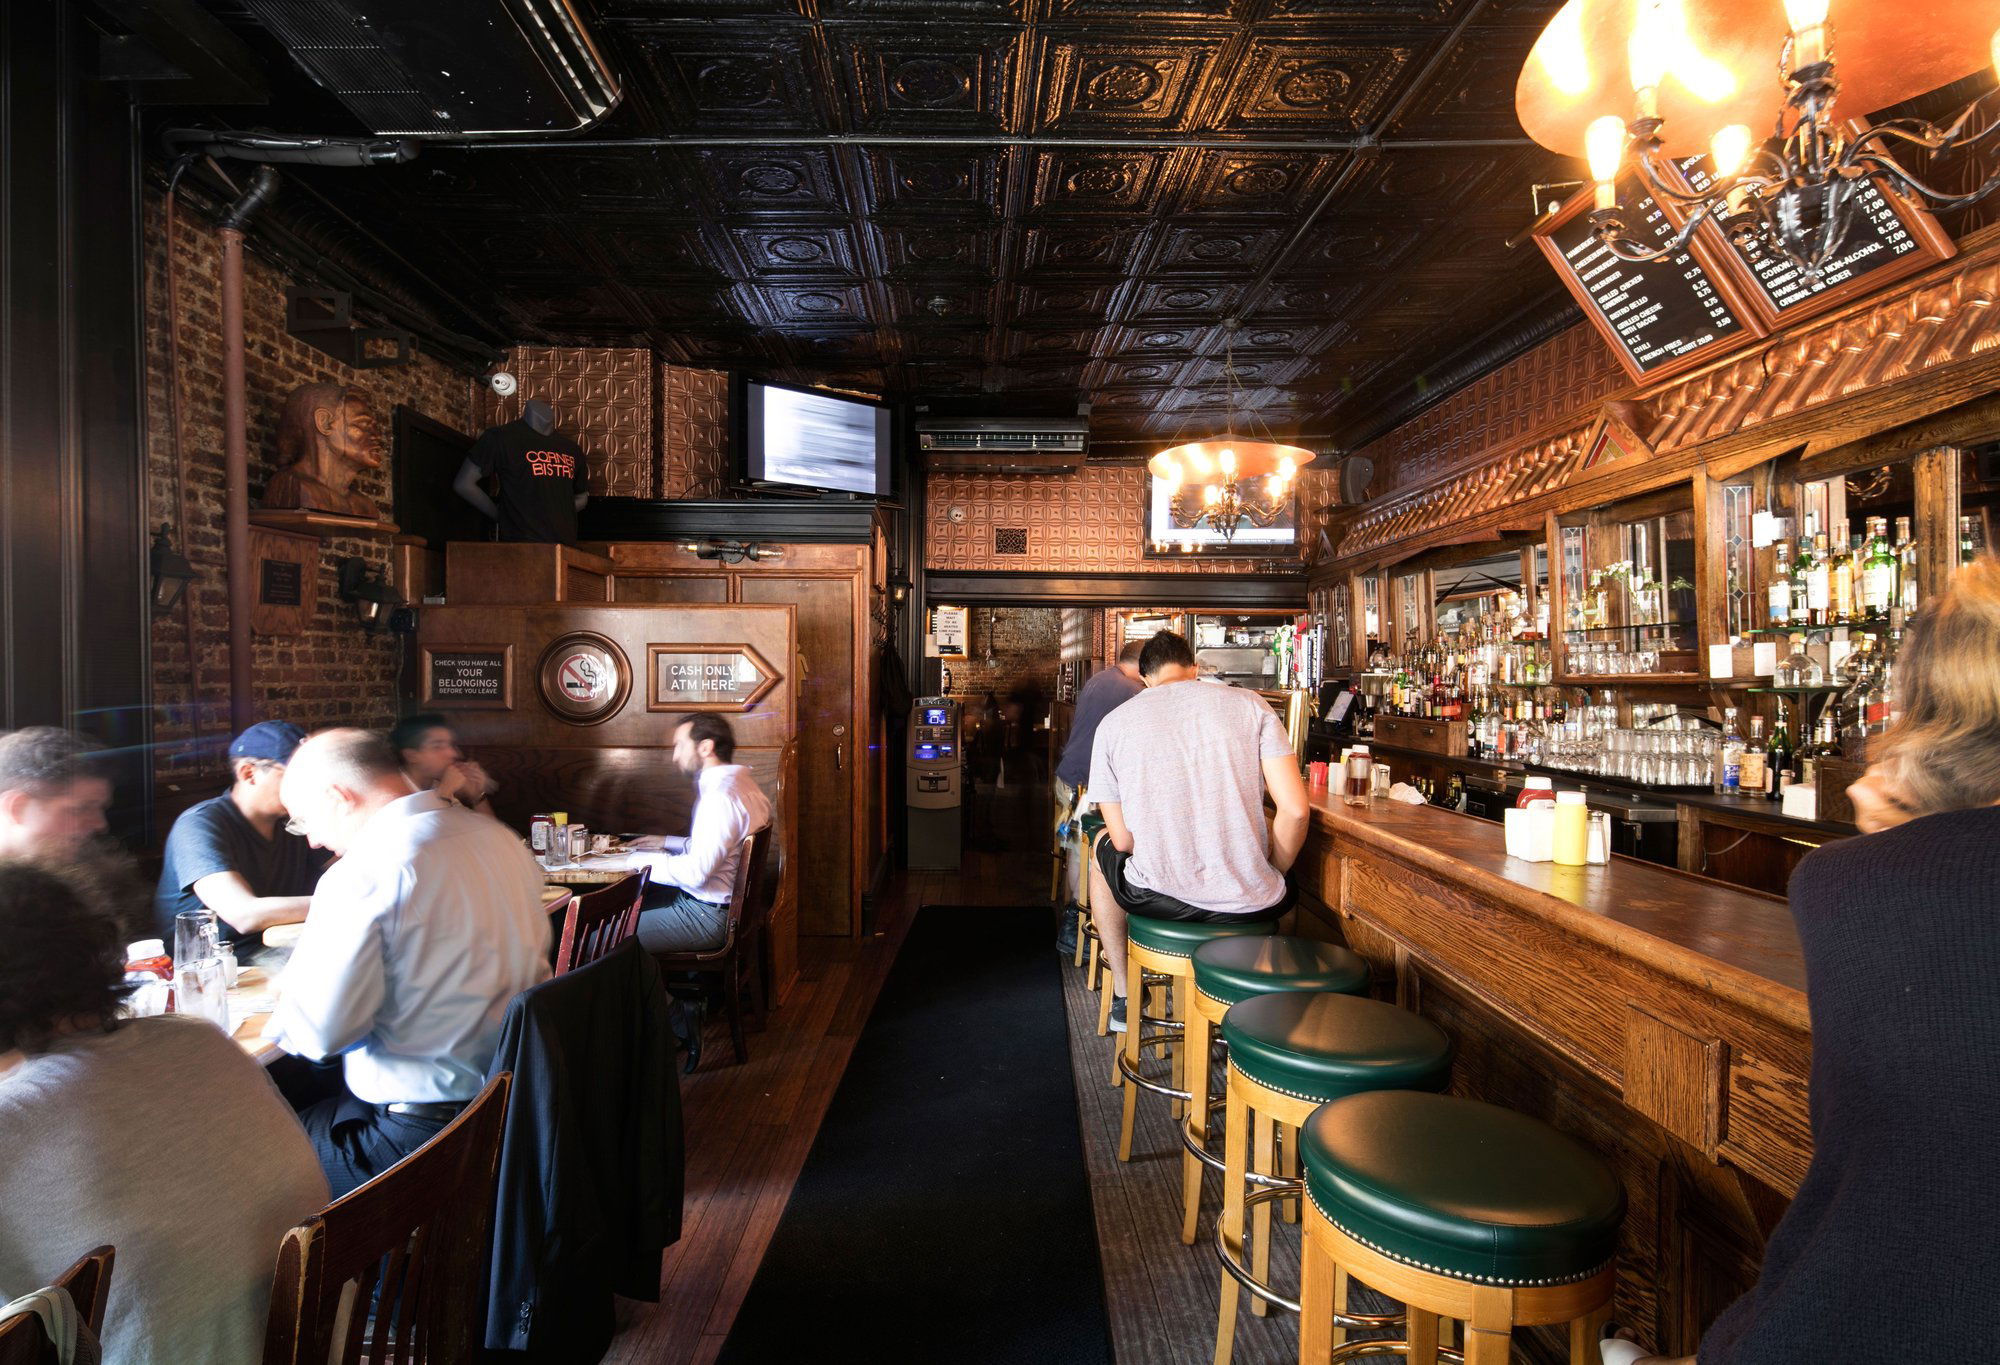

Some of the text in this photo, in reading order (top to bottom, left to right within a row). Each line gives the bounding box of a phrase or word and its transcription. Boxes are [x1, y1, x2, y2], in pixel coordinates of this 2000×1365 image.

[1856, 188, 1877, 204] 7.00
[1863, 199, 1884, 214] 7.00
[1870, 209, 1892, 224] 7.00
[1877, 219, 1899, 234] 8.25
[1574, 244, 1609, 270] CHEESEBURGE
[1824, 242, 1884, 273] NON-ALCOHOL
[1886, 230, 1906, 244] 7.00
[1826, 269, 1852, 285] CIDER
[1893, 240, 1914, 254] 7.00
[1598, 289, 1619, 304] GRILLED
[1620, 274, 1644, 291] CHICKEN
[1609, 306, 1630, 320] BISTRO
[1684, 267, 1702, 280] 12.75
[1617, 315, 1640, 330] GRILLED
[1639, 302, 1663, 319] CHEESE
[1621, 326, 1637, 336] WITH
[1636, 314, 1658, 329] BACON
[1633, 342, 1651, 354] CHILI
[1640, 347, 1665, 362] FRENCH
[1664, 339, 1682, 352] FRIES
[1672, 340, 1698, 356] T-SHIRT
[526, 451, 575, 468] CORNER
[457, 668, 482, 677] YOUR
[671, 666, 735, 676] CASH ONLY
[439, 679, 498, 687] BELONGINGS
[671, 680, 736, 690] ATM HERE
